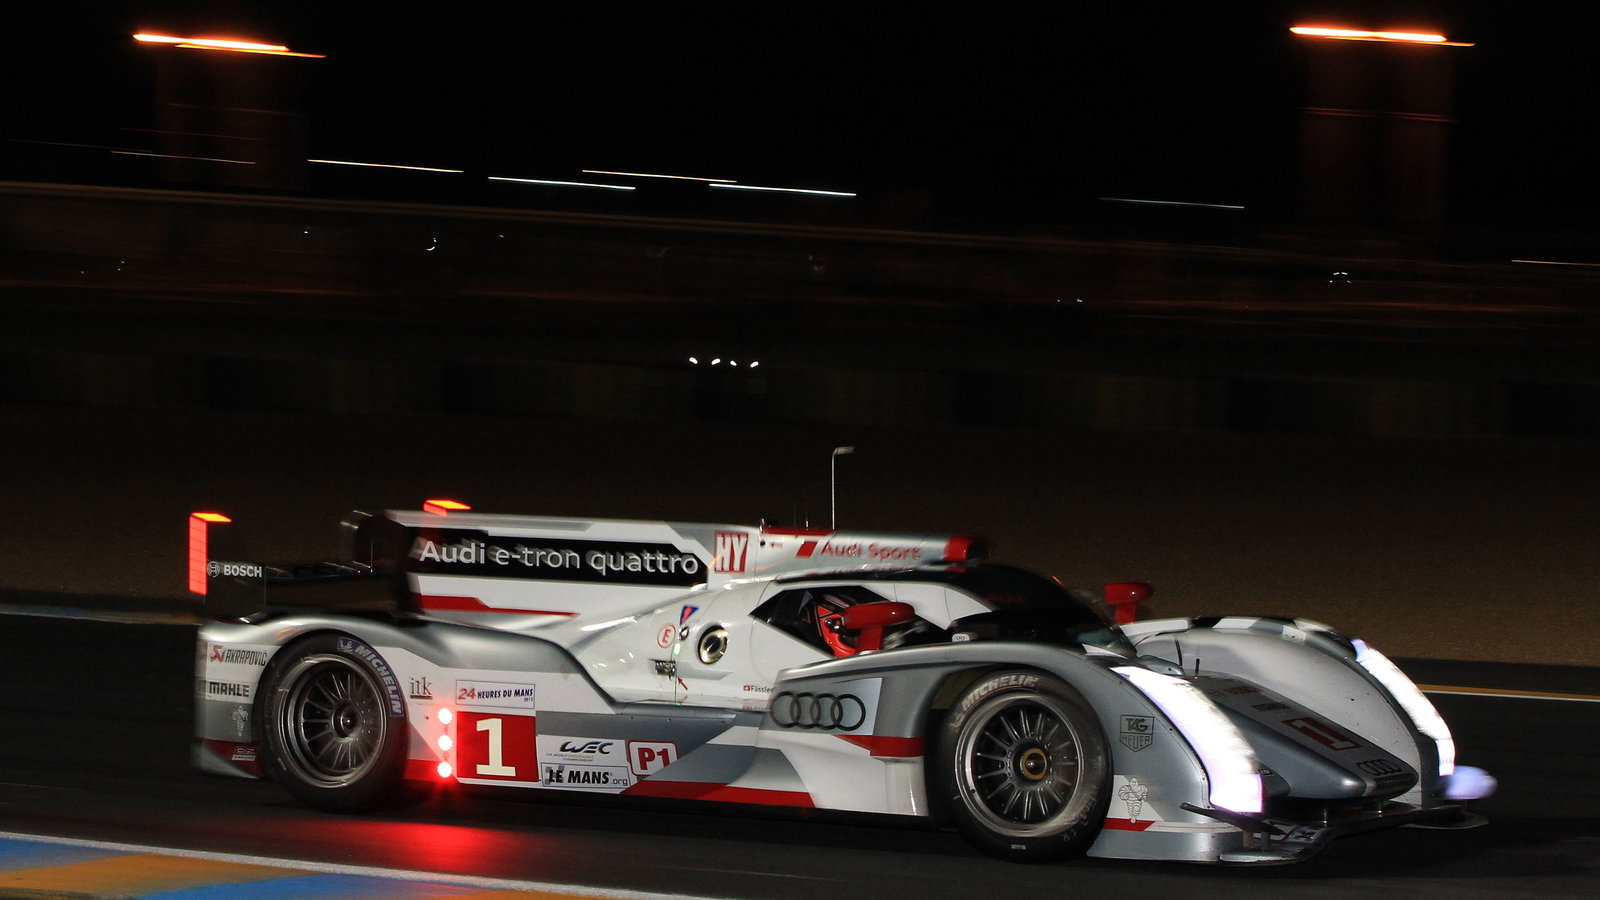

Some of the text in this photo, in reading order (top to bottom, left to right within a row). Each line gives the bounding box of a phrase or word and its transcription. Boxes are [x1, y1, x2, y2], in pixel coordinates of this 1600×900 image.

[420, 540, 699, 576] Audi e-tron quattro
[715, 533, 748, 572] HY
[820, 541, 922, 562] Audi Sport
[223, 564, 263, 578] BOSCH
[661, 628, 670, 643] E
[354, 645, 402, 714] MICHELIN
[410, 676, 432, 695] itk
[209, 681, 250, 698] MAHLE
[458, 687, 533, 700] 24 HEURES DU MANS
[961, 674, 1040, 711] MICHELIN
[1126, 717, 1149, 732] TAG
[476, 717, 516, 777] 1
[560, 740, 614, 755] WEC
[1121, 734, 1151, 749] HEUER
[637, 747, 671, 771] P1
[549, 769, 563, 783] LE
